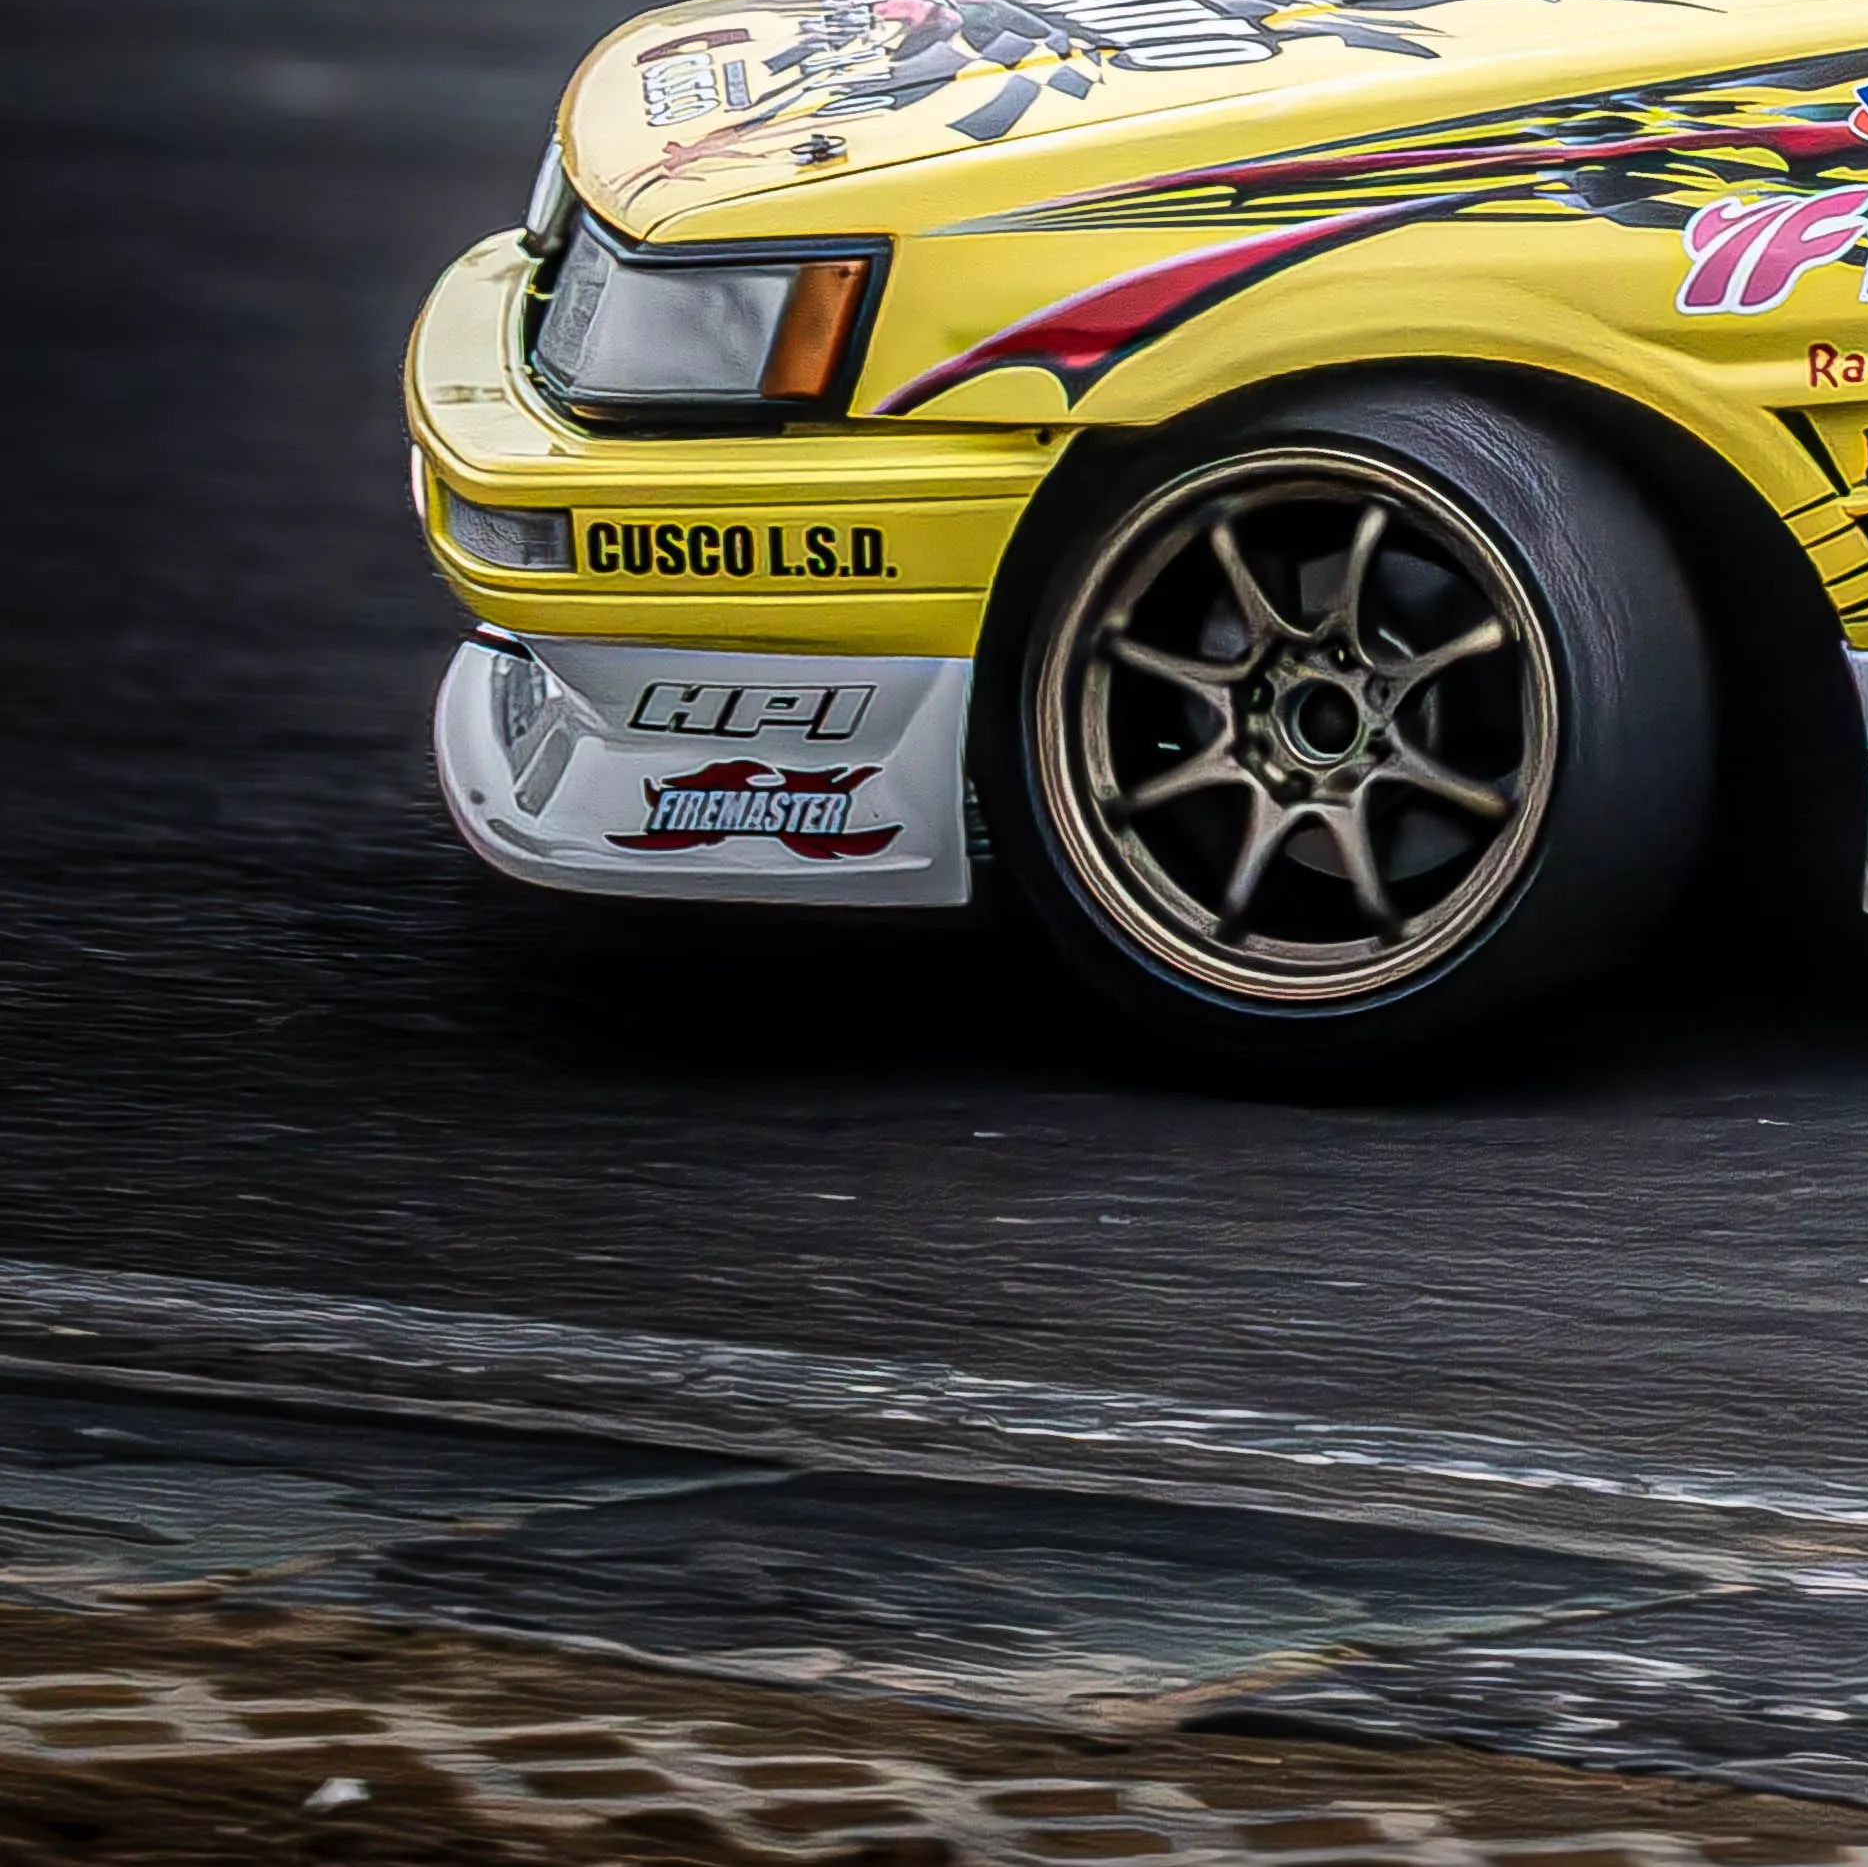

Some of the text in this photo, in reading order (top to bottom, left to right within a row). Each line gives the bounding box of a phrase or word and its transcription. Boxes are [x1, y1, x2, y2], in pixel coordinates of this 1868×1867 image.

[587, 522, 898, 578] CUSCO L.S.D.
[628, 681, 877, 741] HPI
[650, 790, 848, 834] FIREMASTER
